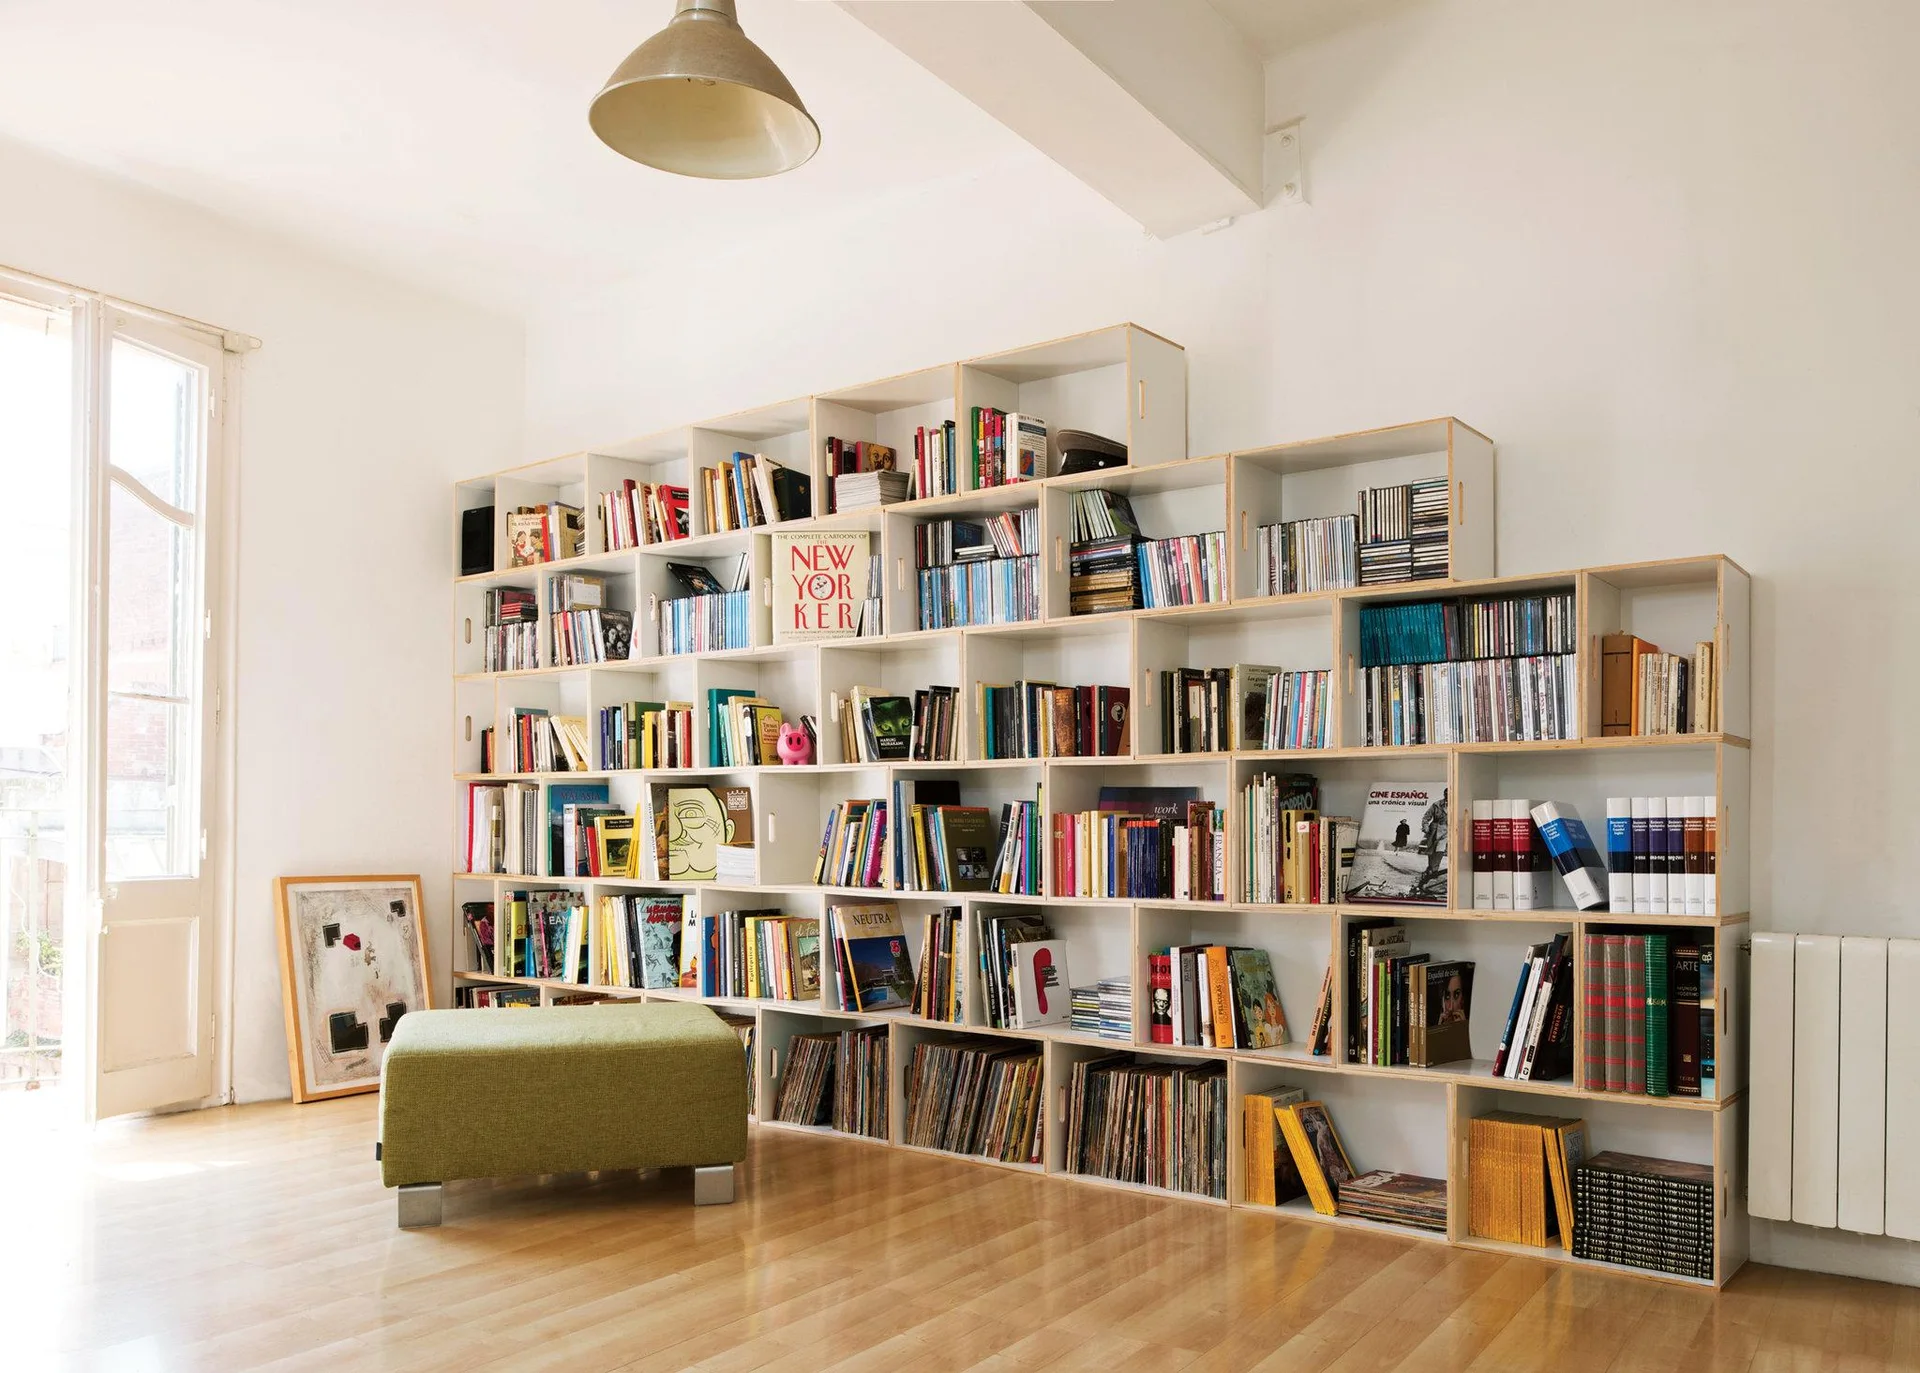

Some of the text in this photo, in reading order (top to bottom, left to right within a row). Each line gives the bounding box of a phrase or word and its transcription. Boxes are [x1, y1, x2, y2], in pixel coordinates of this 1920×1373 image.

[791, 545, 855, 571] NEW
[791, 573, 854, 601] YOR
[794, 603, 856, 629] KER
[1391, 790, 1429, 799] ESPAÑOL
[1154, 803, 1178, 814] work
[853, 913, 892, 925] NEUTRA
[1676, 961, 1699, 972] ARTE
